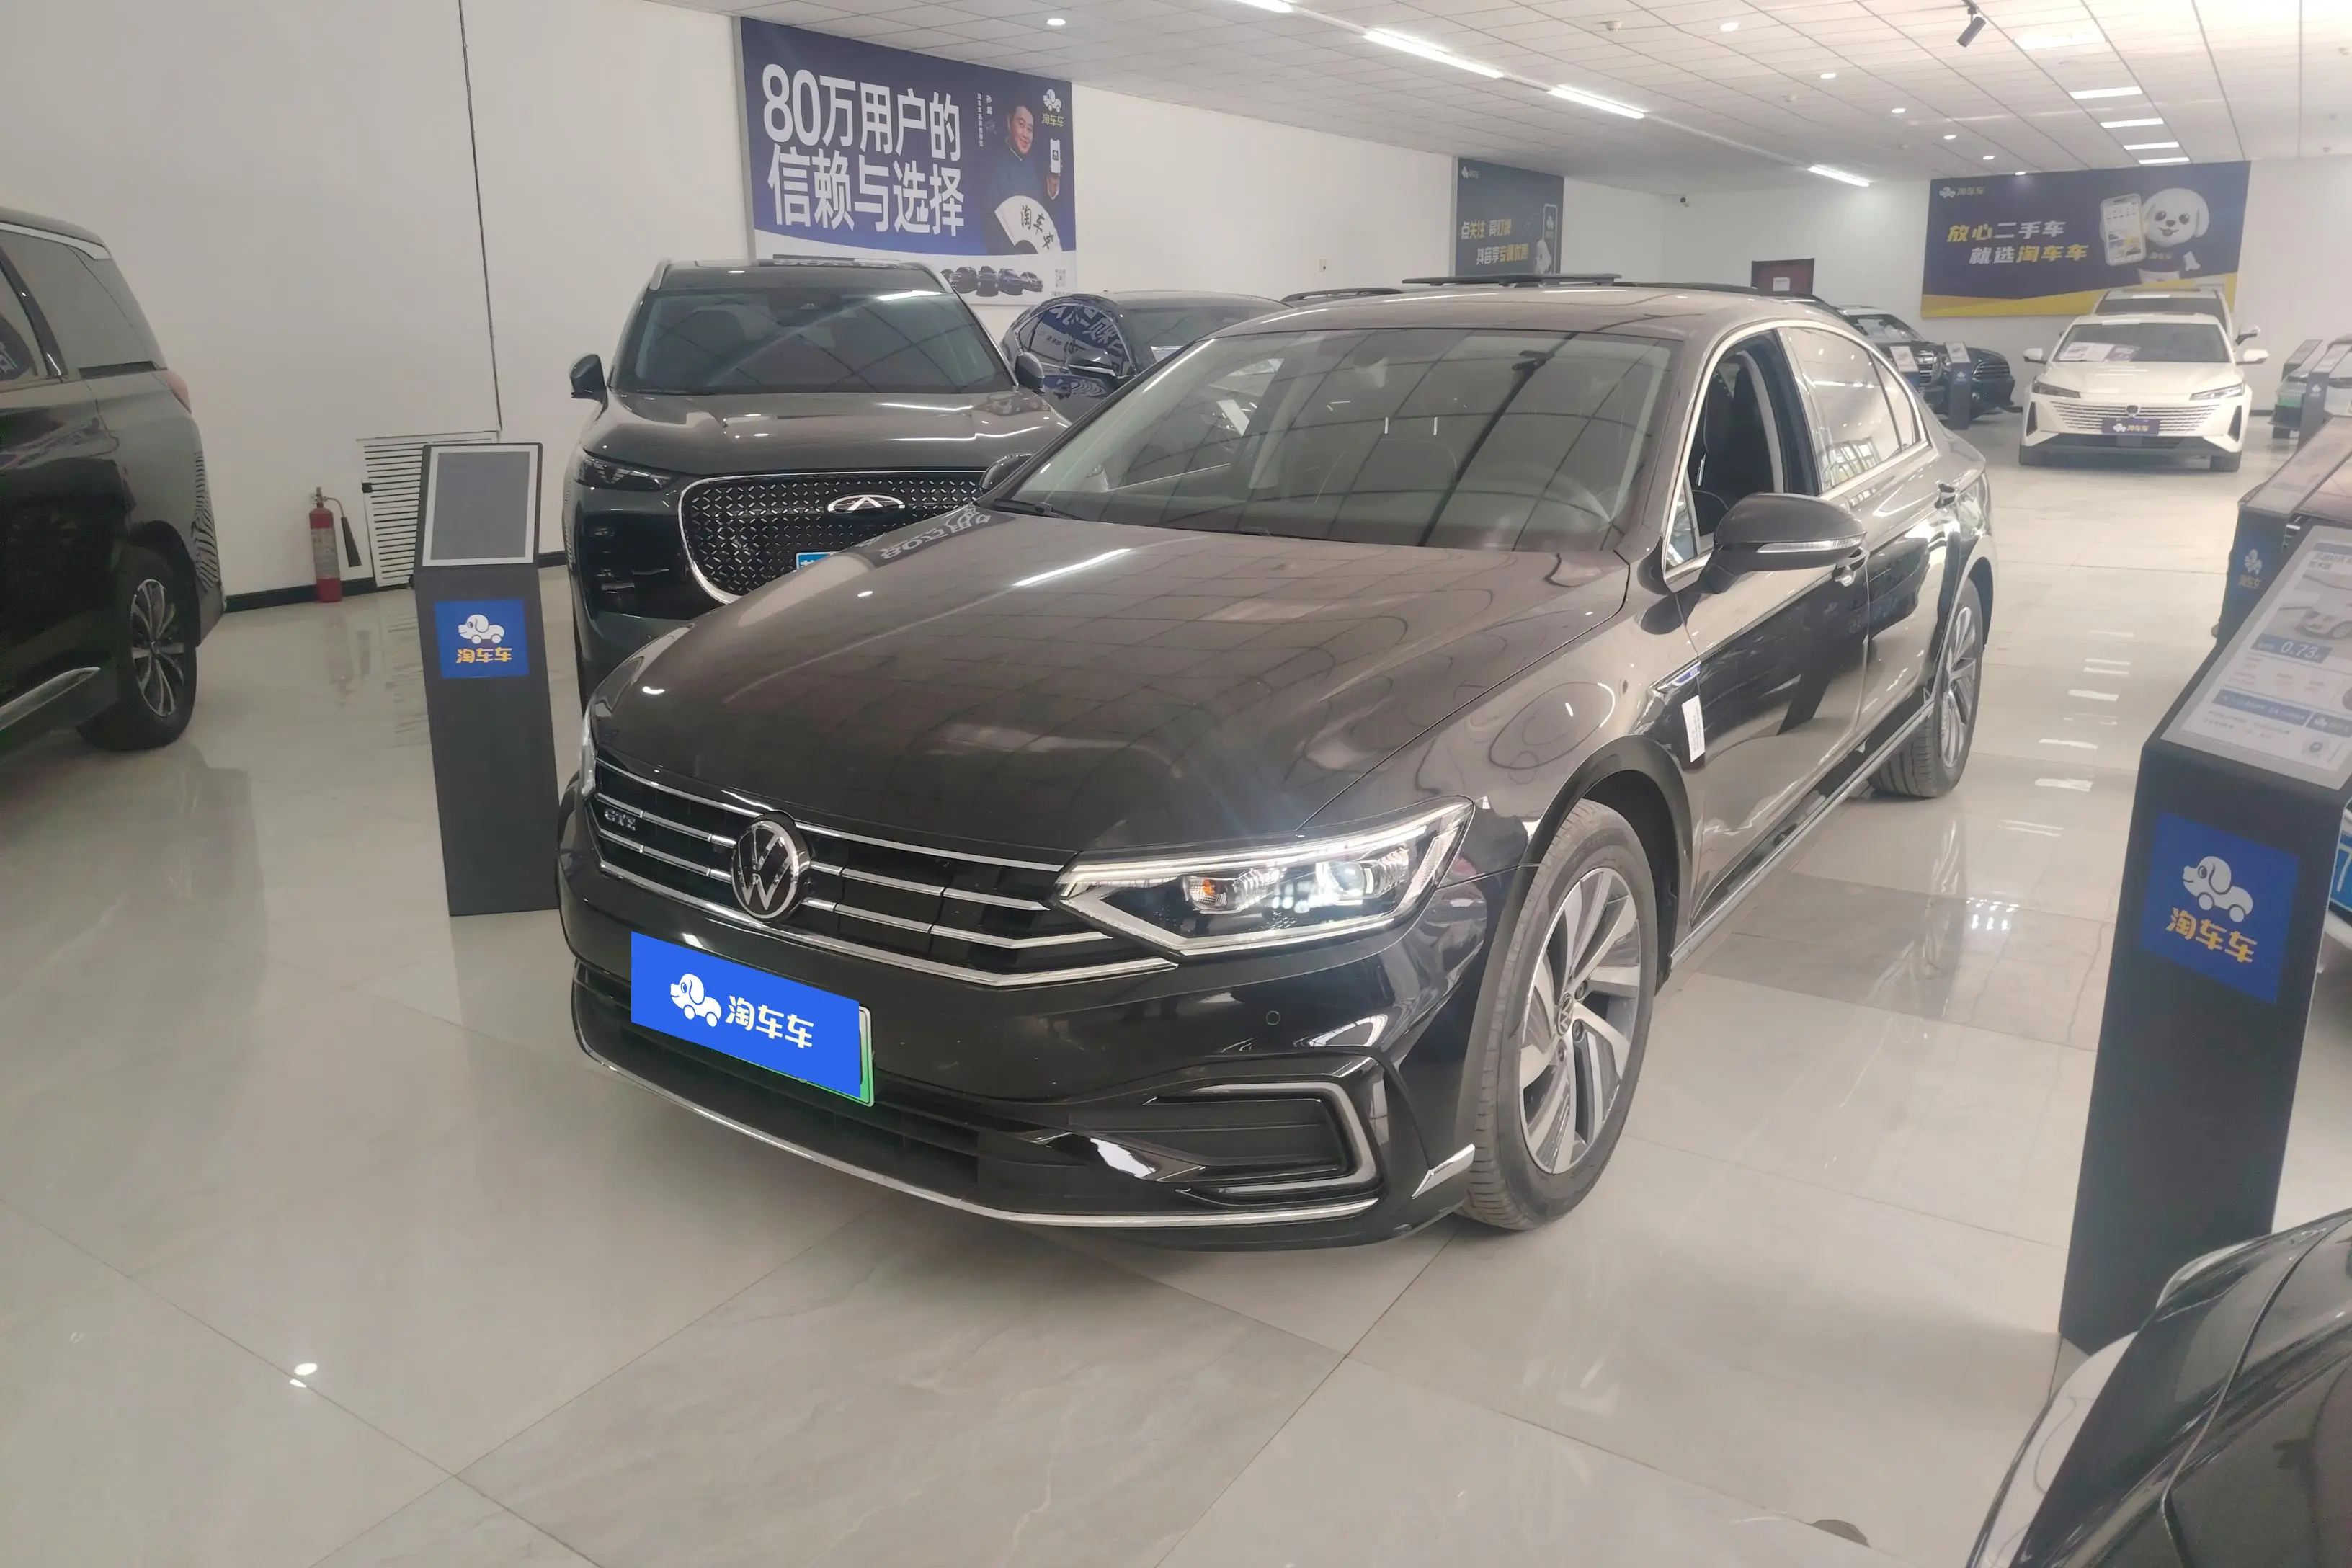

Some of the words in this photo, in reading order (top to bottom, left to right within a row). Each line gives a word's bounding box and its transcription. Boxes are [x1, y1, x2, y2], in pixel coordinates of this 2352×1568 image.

[762, 63, 961, 162] 80万用户的
[1041, 112, 1064, 128] 淘车车
[767, 143, 965, 237] 信赖与选择
[1020, 204, 1054, 251] 淘车车
[1946, 220, 2067, 243] 放心二手车
[1968, 244, 2090, 265] 就选淘车车
[455, 647, 512, 664] 淘车车
[2281, 641, 2319, 659] 0.73
[2165, 906, 2257, 963] 淘车车
